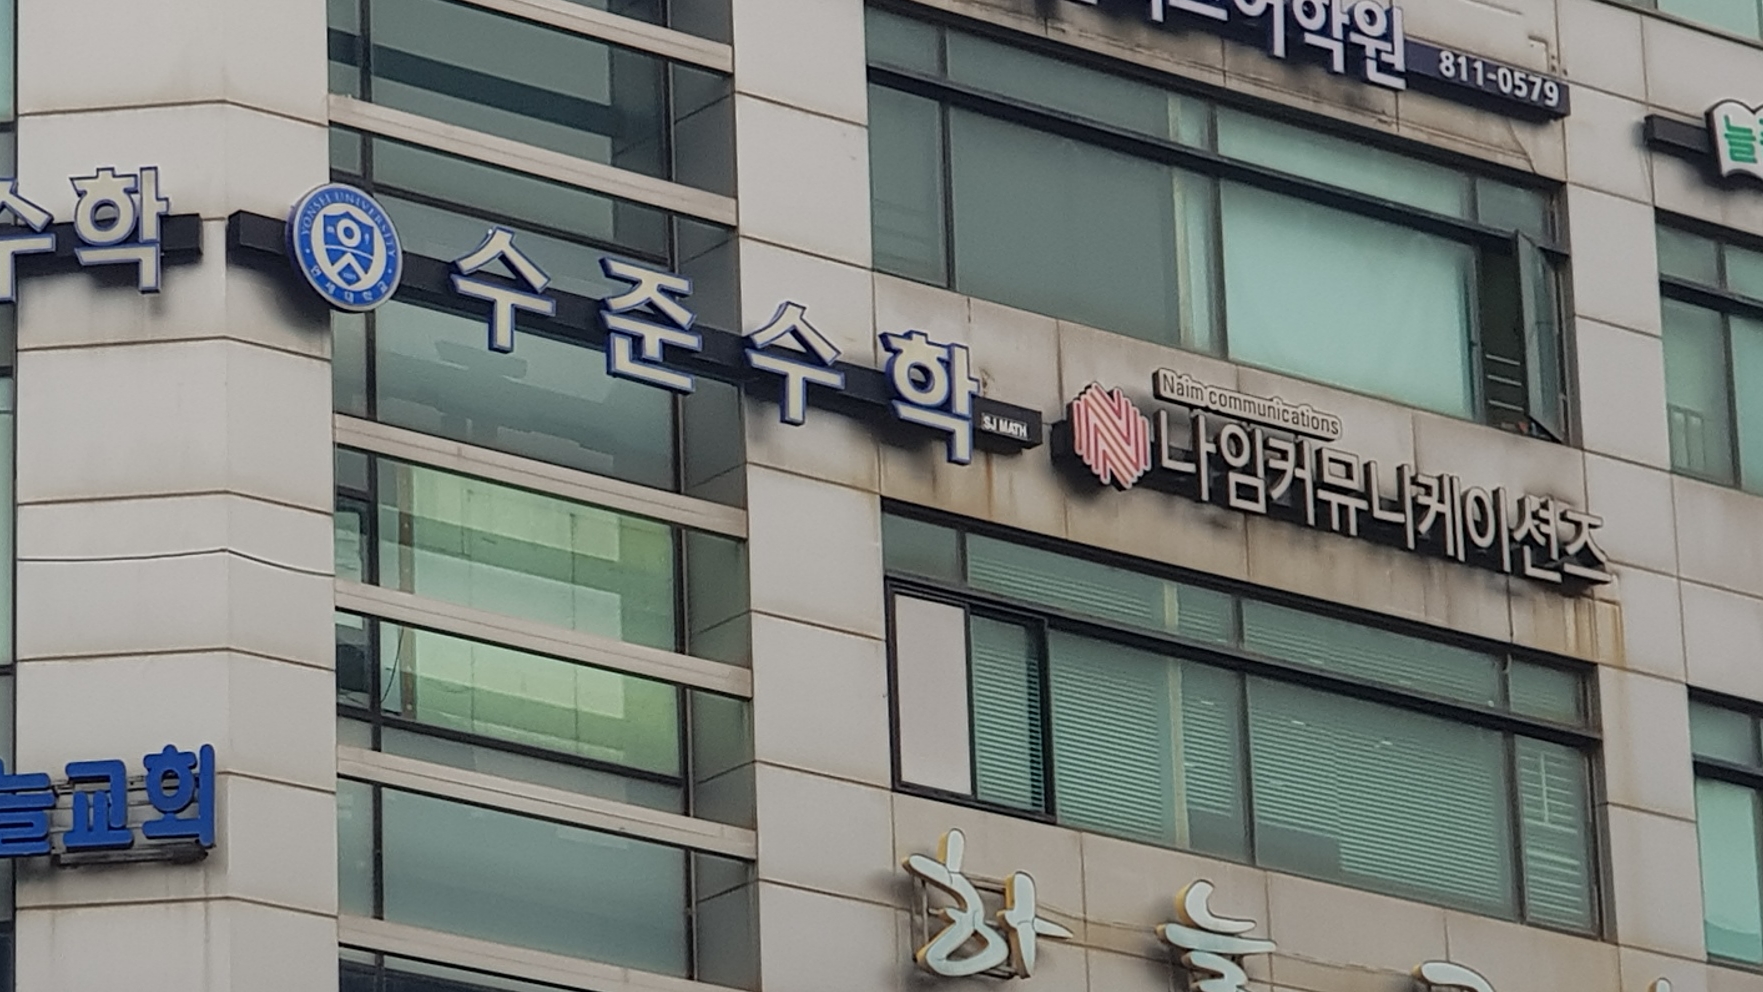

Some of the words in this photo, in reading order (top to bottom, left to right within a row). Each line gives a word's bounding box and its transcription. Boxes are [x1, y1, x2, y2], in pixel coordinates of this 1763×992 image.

[1439, 49, 1561, 109] 811-0579
[301, 194, 331, 236] YONSEI
[450, 226, 981, 466] 수준수학
[983, 415, 996, 431] SJ
[999, 418, 1028, 438] MATH
[1162, 373, 1205, 402] Naim
[1209, 389, 1340, 436] communications
[1158, 409, 1613, 584] 나임커뮤니케이션즈
